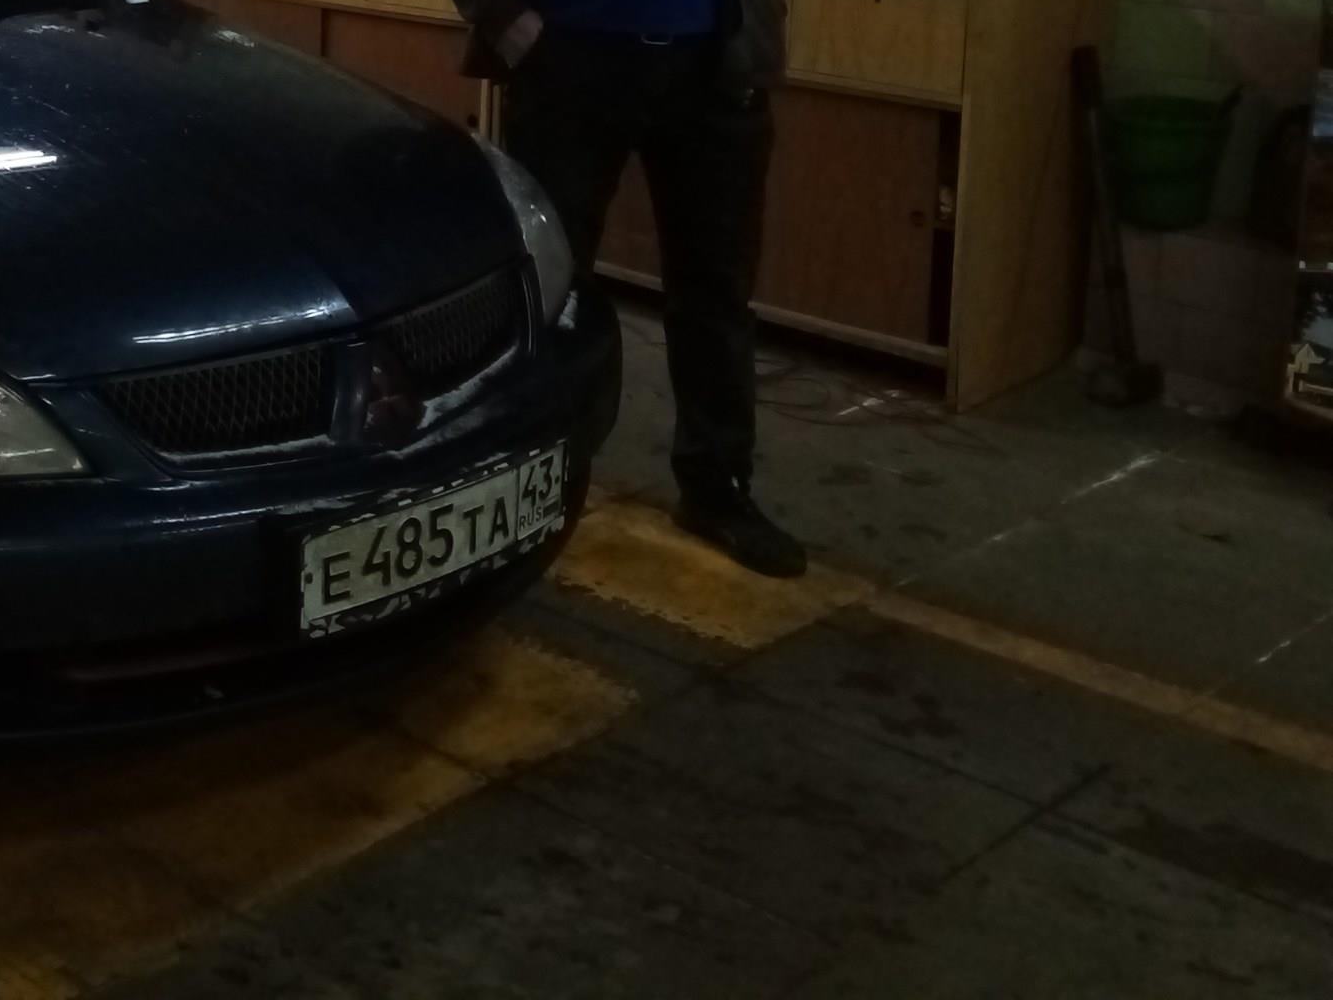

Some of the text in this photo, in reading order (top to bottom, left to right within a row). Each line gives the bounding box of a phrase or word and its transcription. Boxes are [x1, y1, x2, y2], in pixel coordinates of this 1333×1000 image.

[321, 454, 555, 606] Е485ТА 43
[519, 506, 543, 530] RUS
